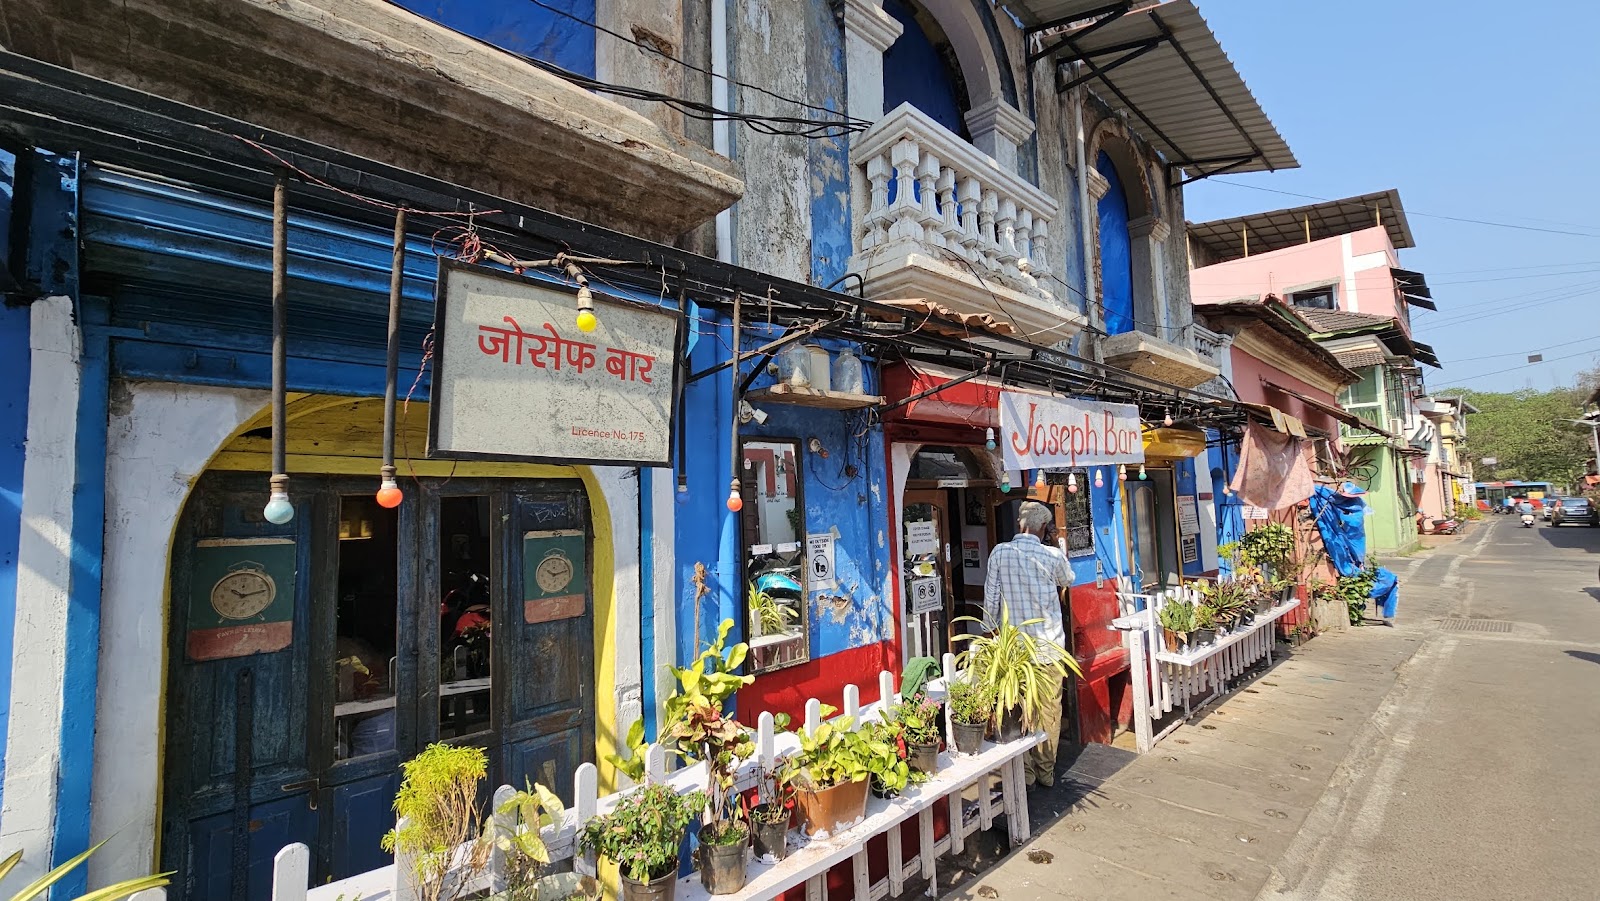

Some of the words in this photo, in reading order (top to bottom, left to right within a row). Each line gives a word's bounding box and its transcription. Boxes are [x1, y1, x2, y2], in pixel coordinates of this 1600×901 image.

[478, 315, 596, 374] जोसेफ
[605, 347, 656, 383] बार
[571, 425, 611, 439] Licence
[1012, 402, 1098, 467] Joseph
[1103, 409, 1138, 456] Bar
